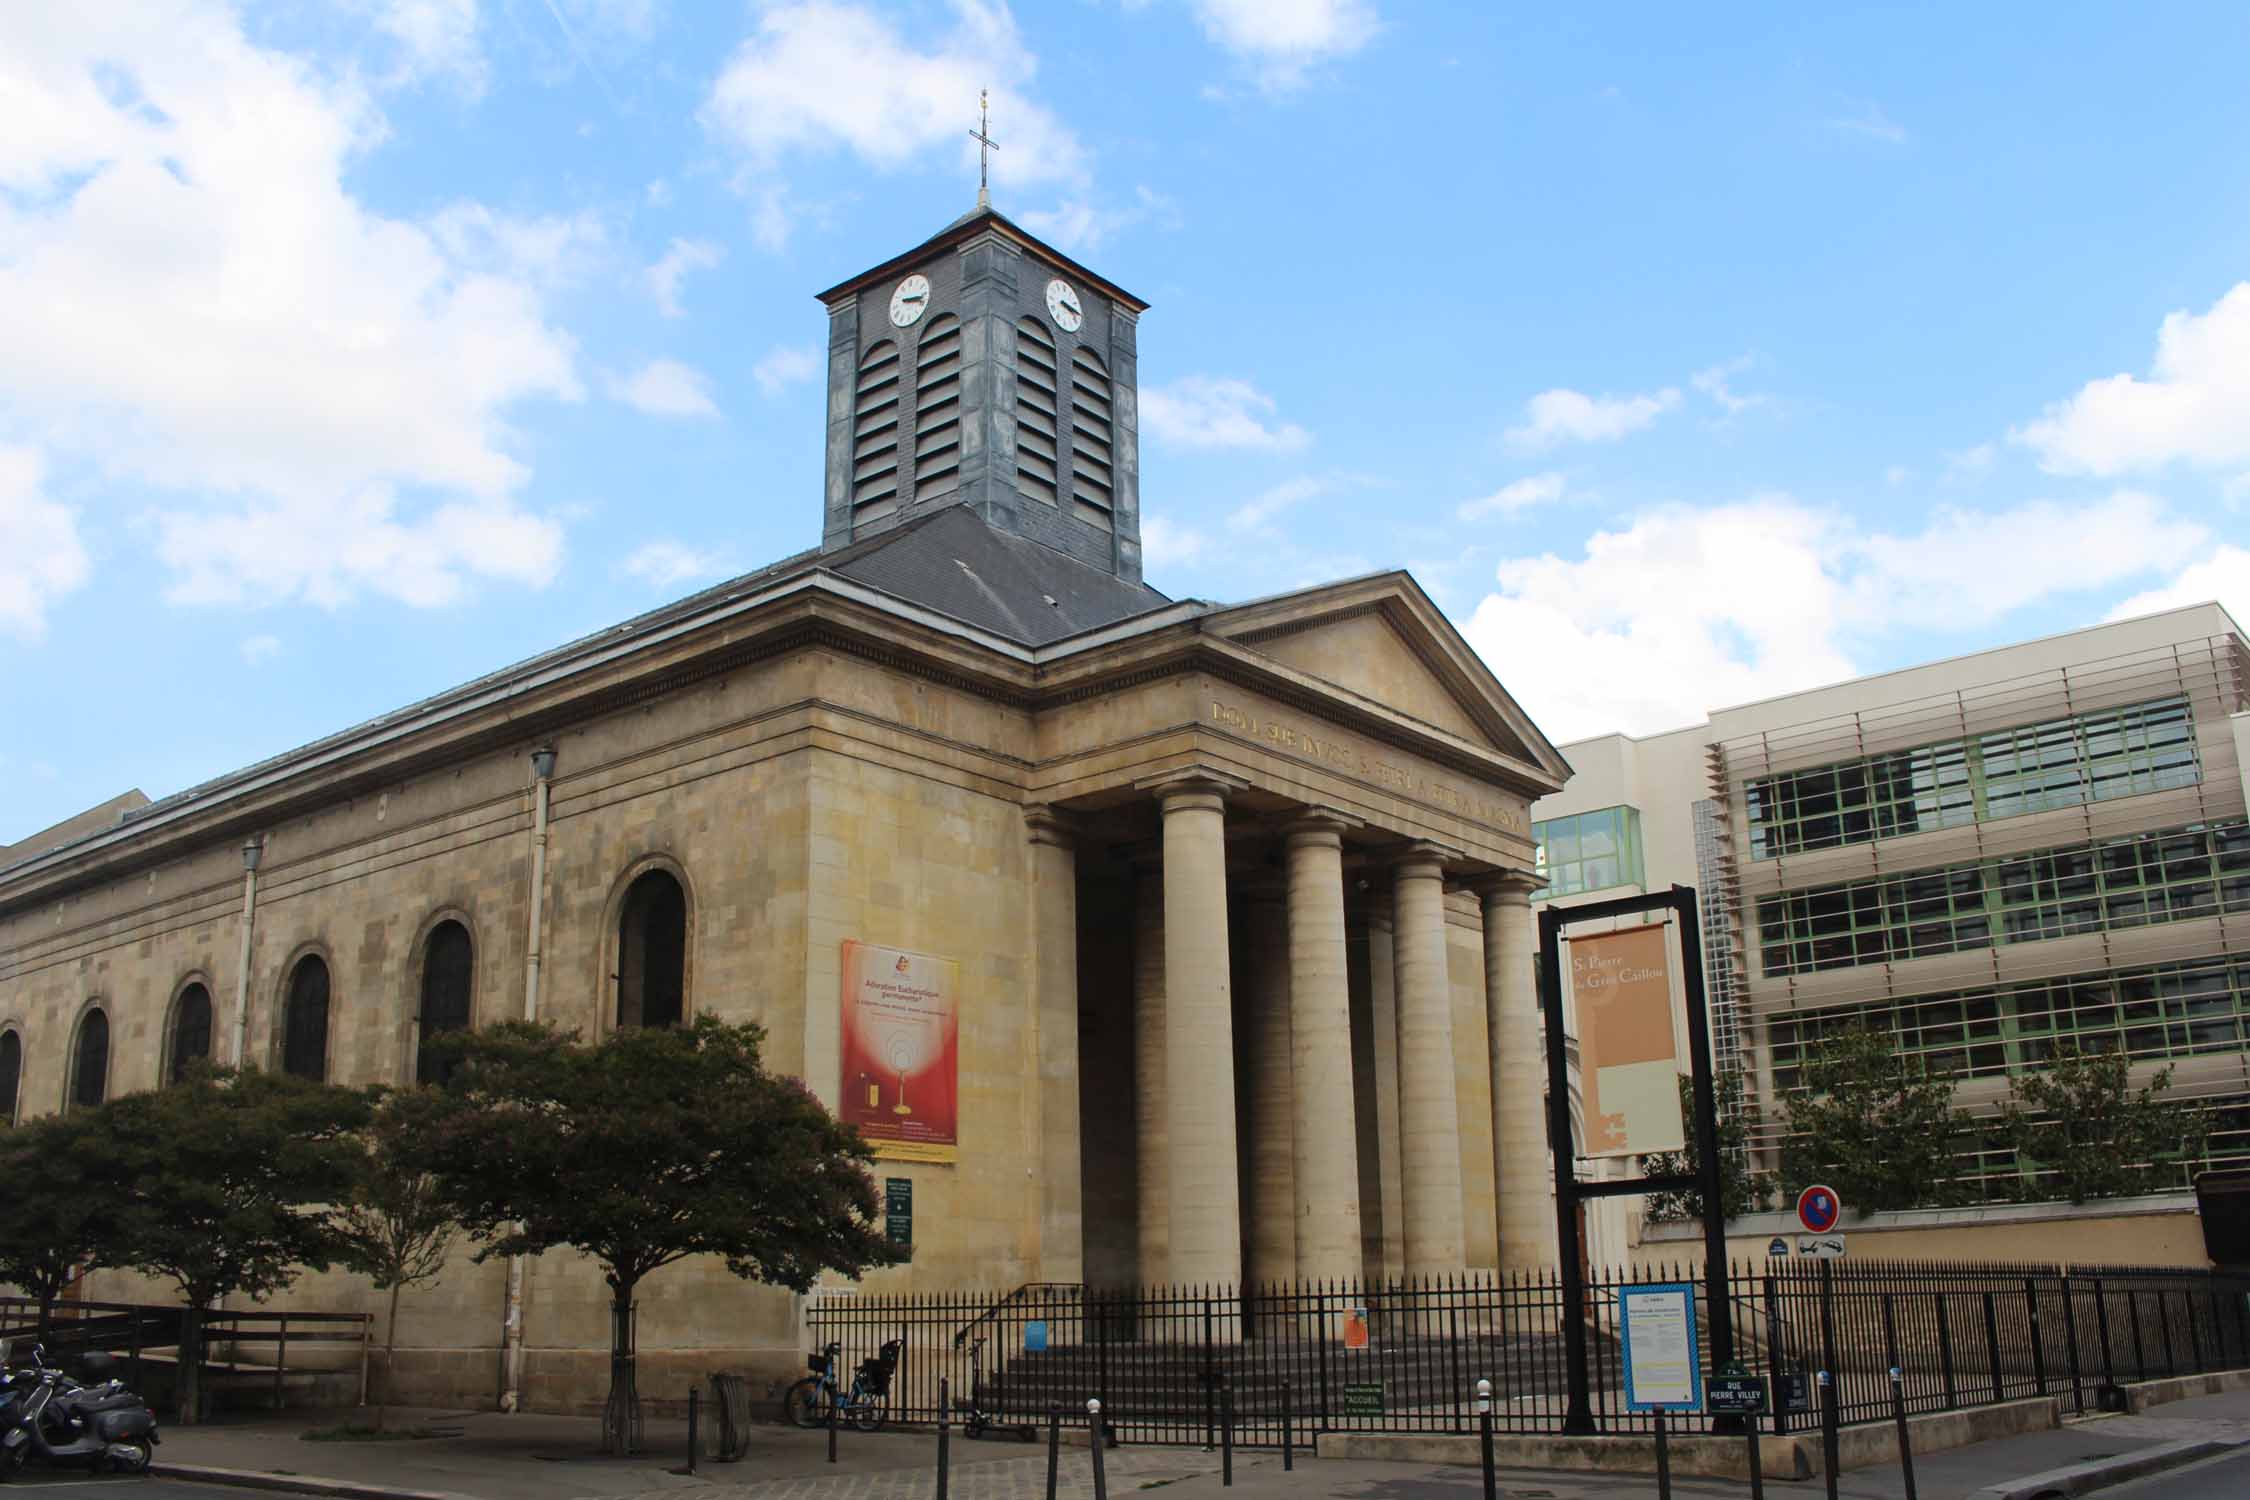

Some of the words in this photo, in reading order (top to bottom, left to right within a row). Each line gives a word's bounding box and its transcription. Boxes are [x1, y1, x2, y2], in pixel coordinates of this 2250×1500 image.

[1589, 955, 1623, 969] Pierre
[1619, 966, 1664, 983] Caillou
[1727, 1381, 1742, 1390] RUE
[1710, 1391, 1735, 1400] PIERRE
[1737, 1391, 1760, 1399] VILLEY
